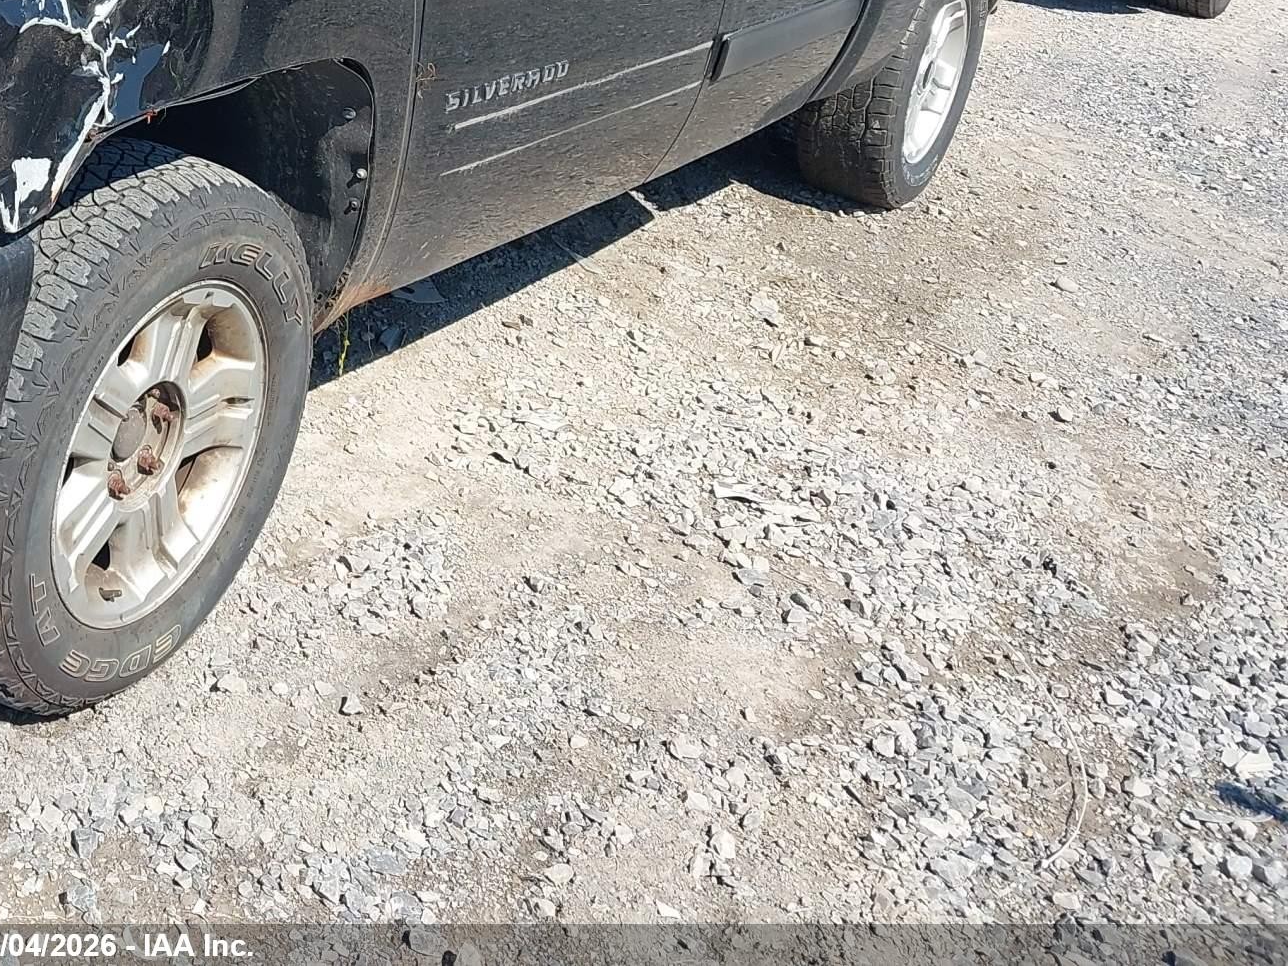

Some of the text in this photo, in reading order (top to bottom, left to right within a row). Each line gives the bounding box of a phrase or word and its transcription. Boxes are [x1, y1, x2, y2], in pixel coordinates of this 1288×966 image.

[444, 59, 570, 113] SILVERADO
[198, 241, 304, 327] KELLY
[29, 573, 182, 683] EDGE AT
